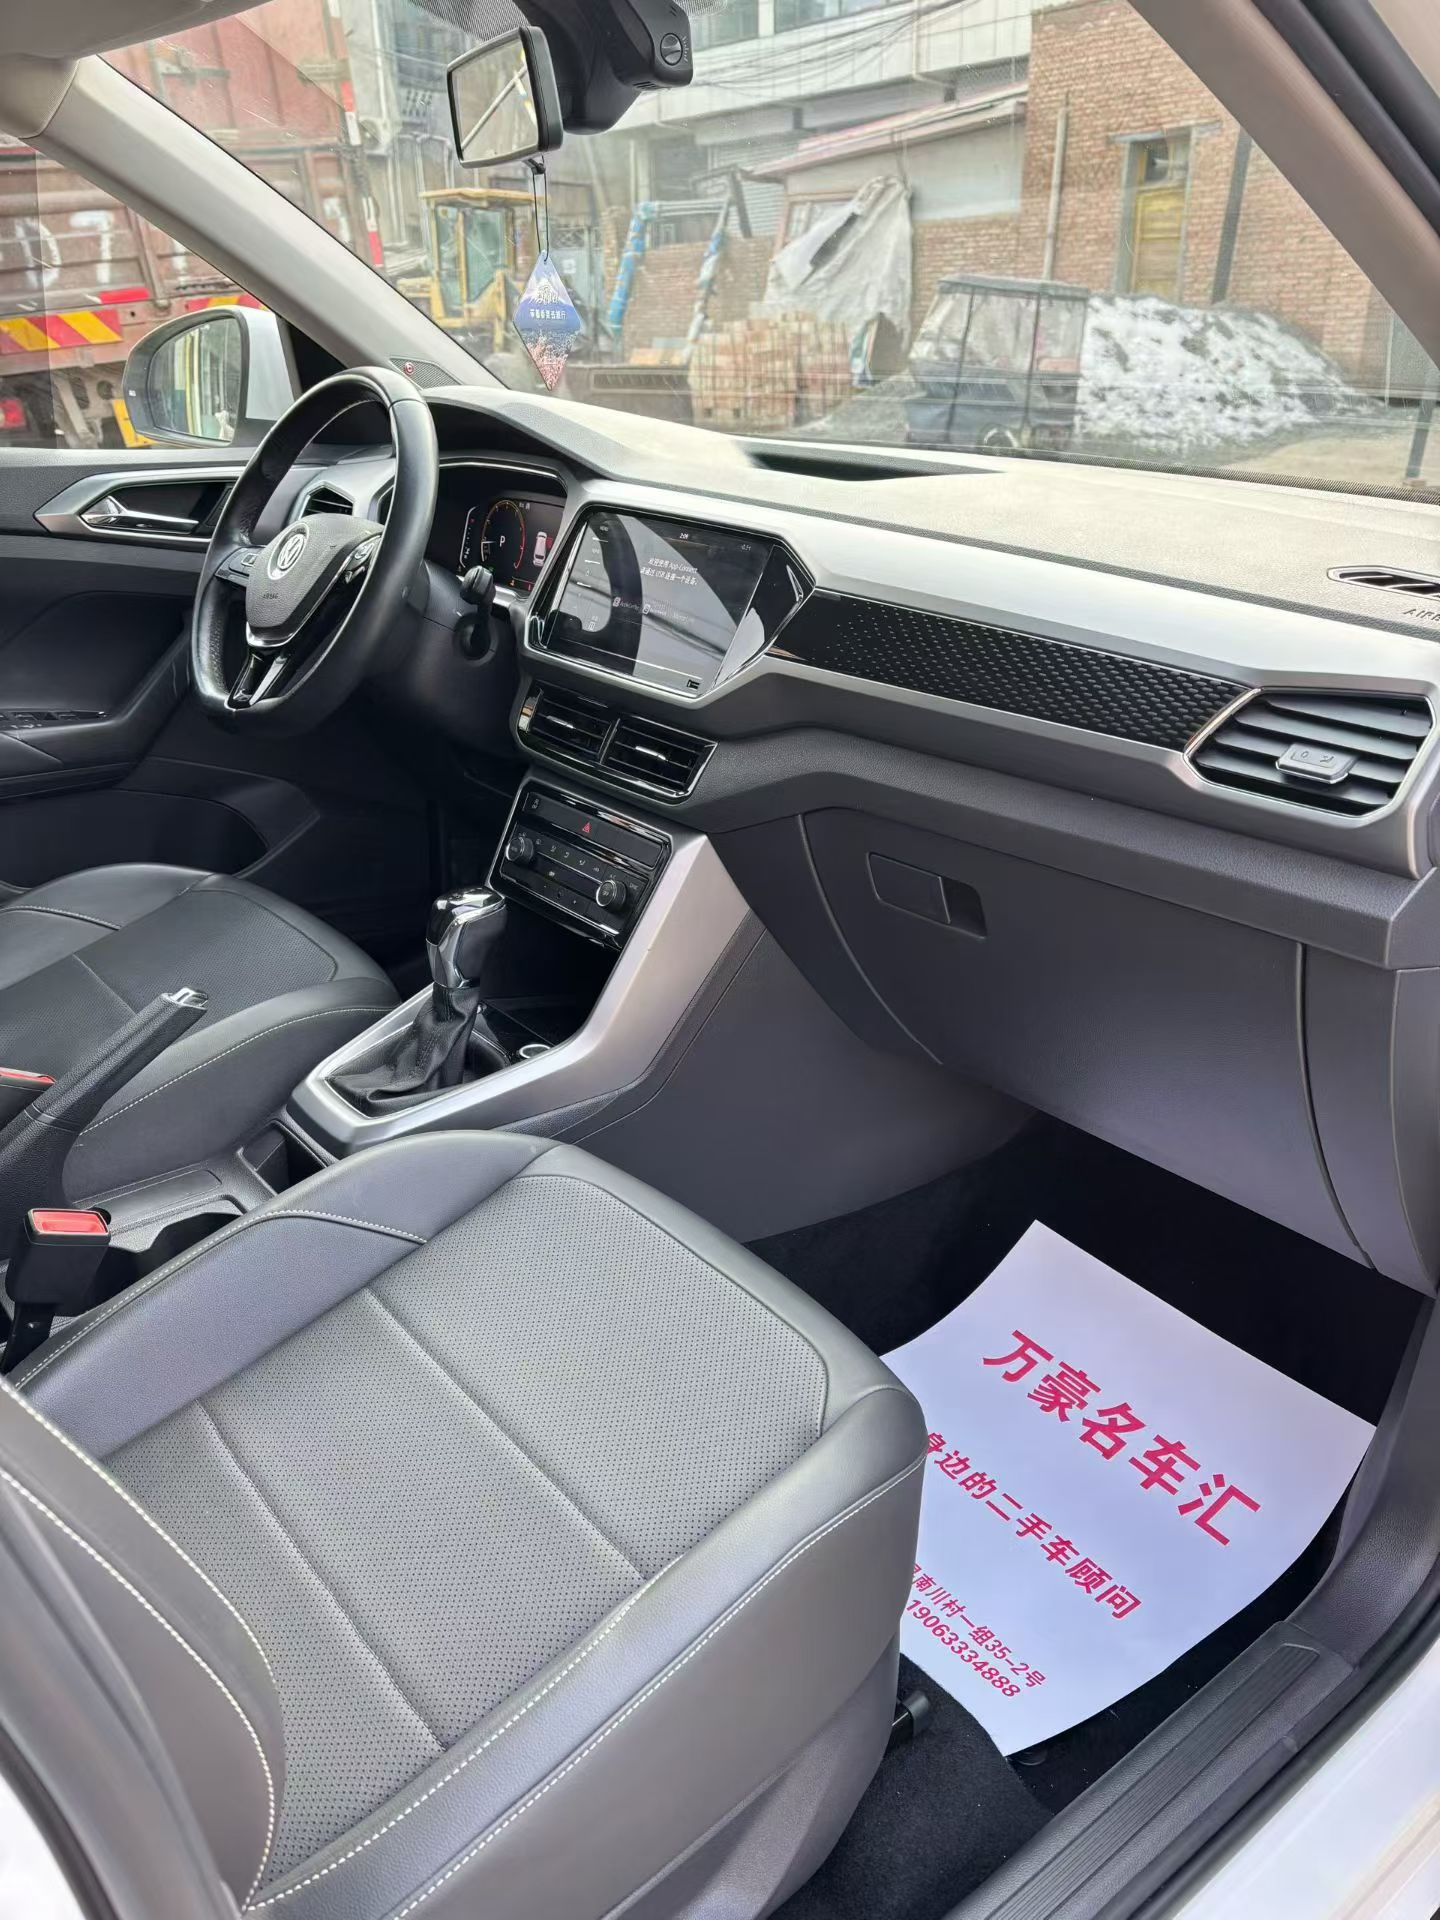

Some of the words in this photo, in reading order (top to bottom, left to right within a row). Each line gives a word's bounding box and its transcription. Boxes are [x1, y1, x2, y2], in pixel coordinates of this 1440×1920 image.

[927, 1432, 1142, 1620] 身边的二手车顾问
[982, 1330, 1261, 1546] 万豪名车汇
[906, 1599, 1021, 1698] 19063334888
